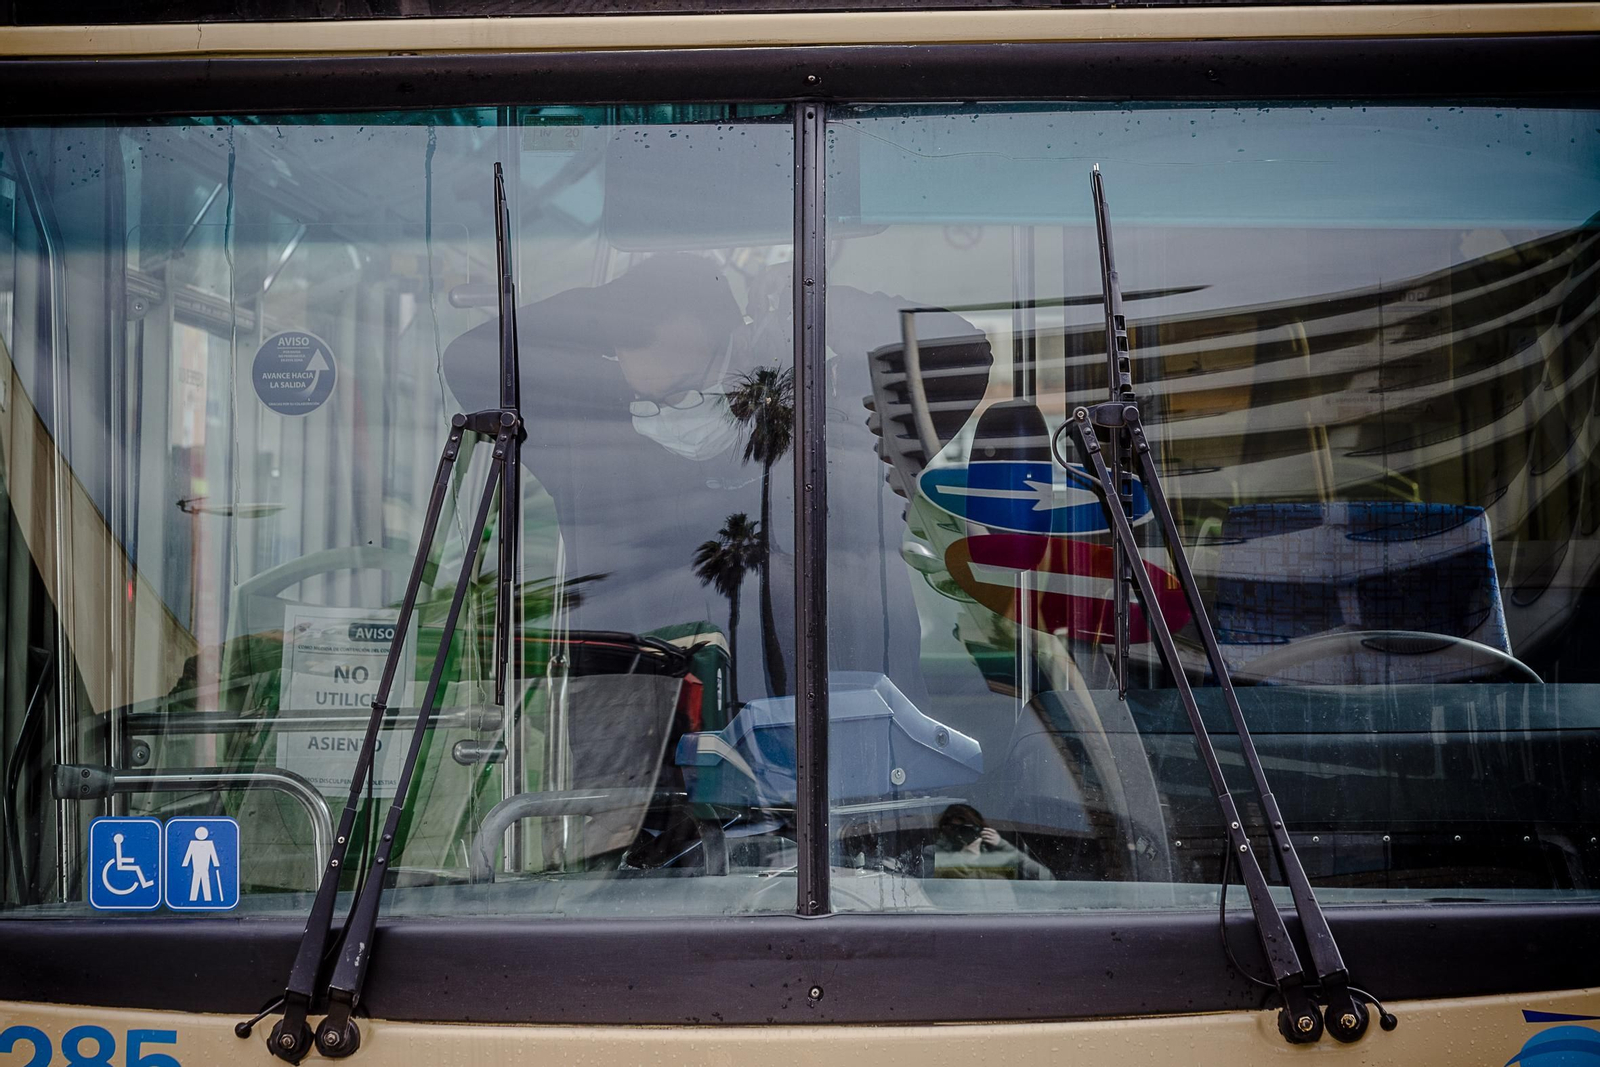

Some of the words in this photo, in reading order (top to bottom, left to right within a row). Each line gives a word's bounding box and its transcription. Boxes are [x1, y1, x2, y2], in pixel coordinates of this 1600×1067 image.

[278, 337, 310, 346] AVISO
[262, 372, 291, 380] AVANCE
[355, 627, 395, 640] AVISO
[333, 665, 370, 684] NO
[307, 736, 382, 753] ASIENO
[0, 1025, 182, 1067] 285
